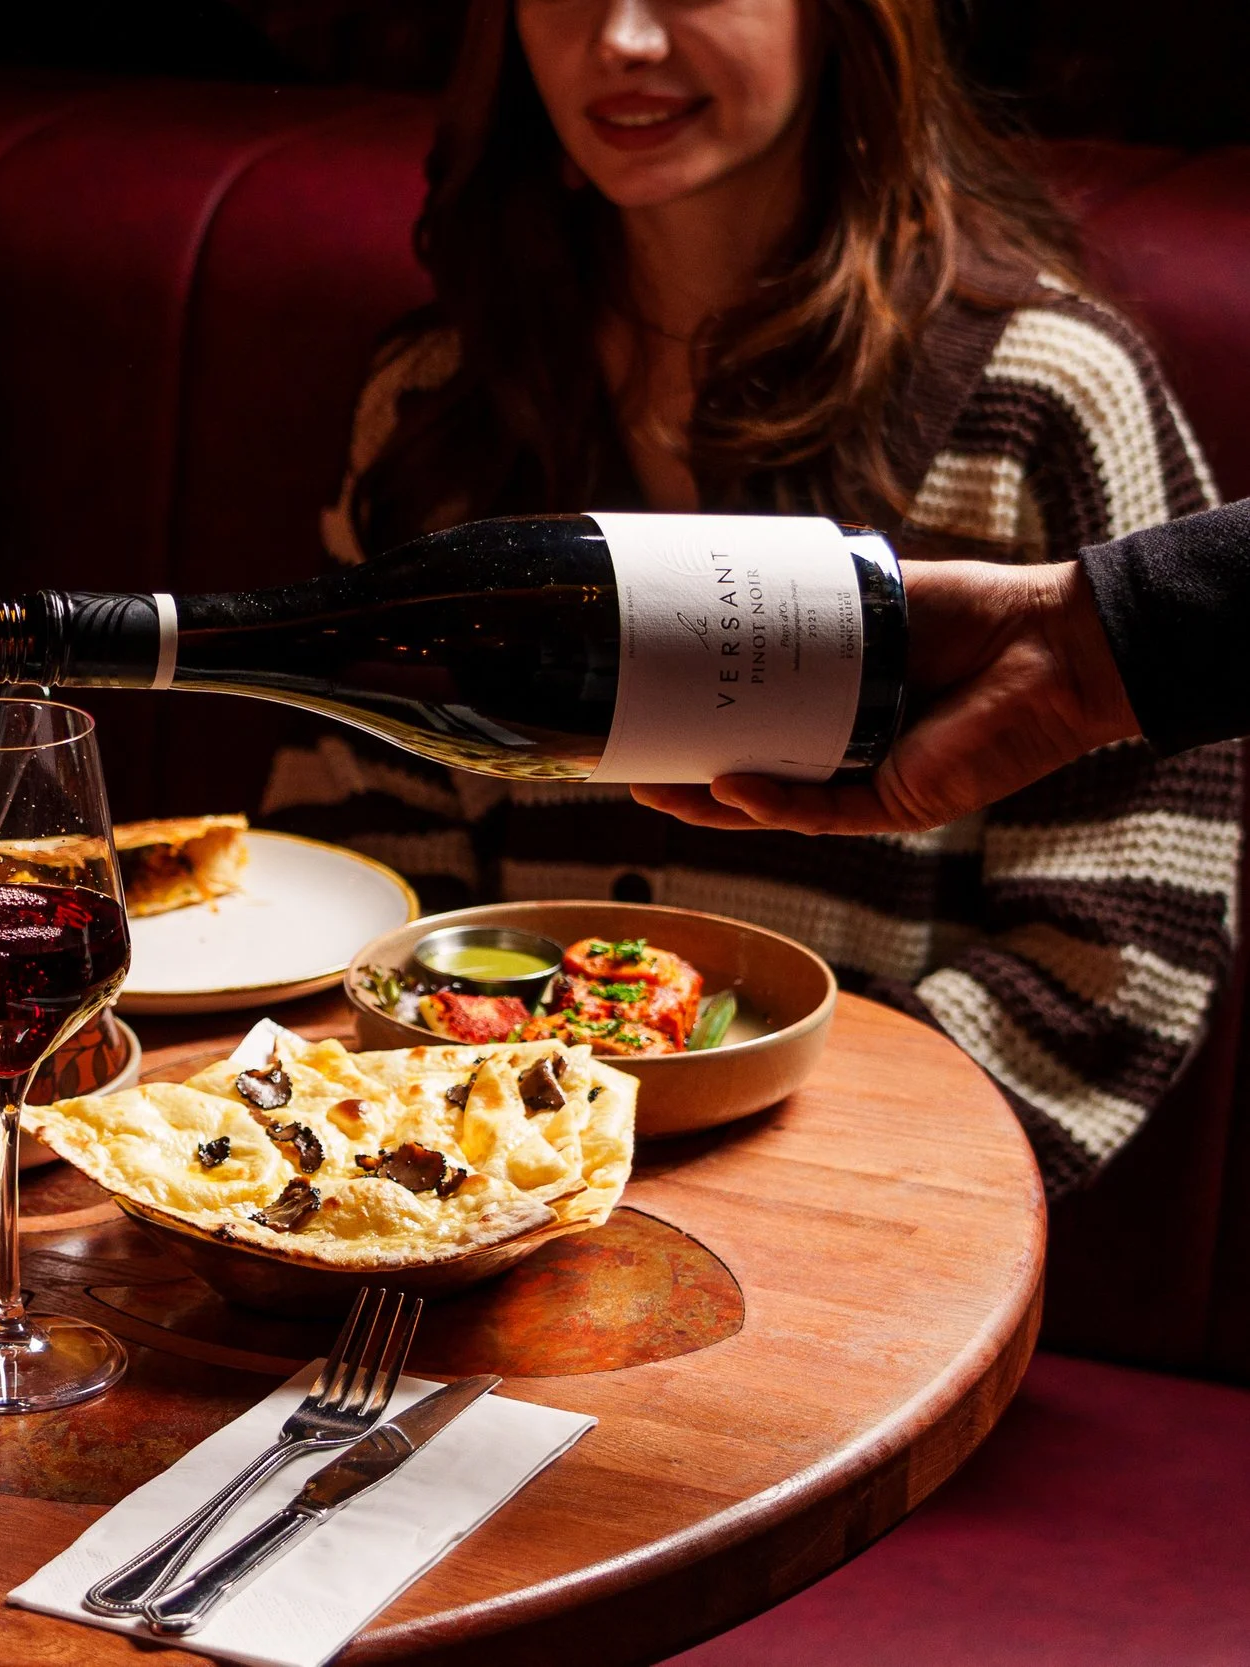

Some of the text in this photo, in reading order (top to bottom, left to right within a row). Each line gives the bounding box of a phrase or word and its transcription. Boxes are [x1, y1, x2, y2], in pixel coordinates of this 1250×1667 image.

[676, 612, 710, 651] le
[711, 550, 740, 709] VERSANT
[747, 568, 767, 684] PINOT NOIR
[780, 623, 791, 649] Pays
[807, 609, 818, 638] 2023
[843, 592, 854, 660] FONCALIEU
